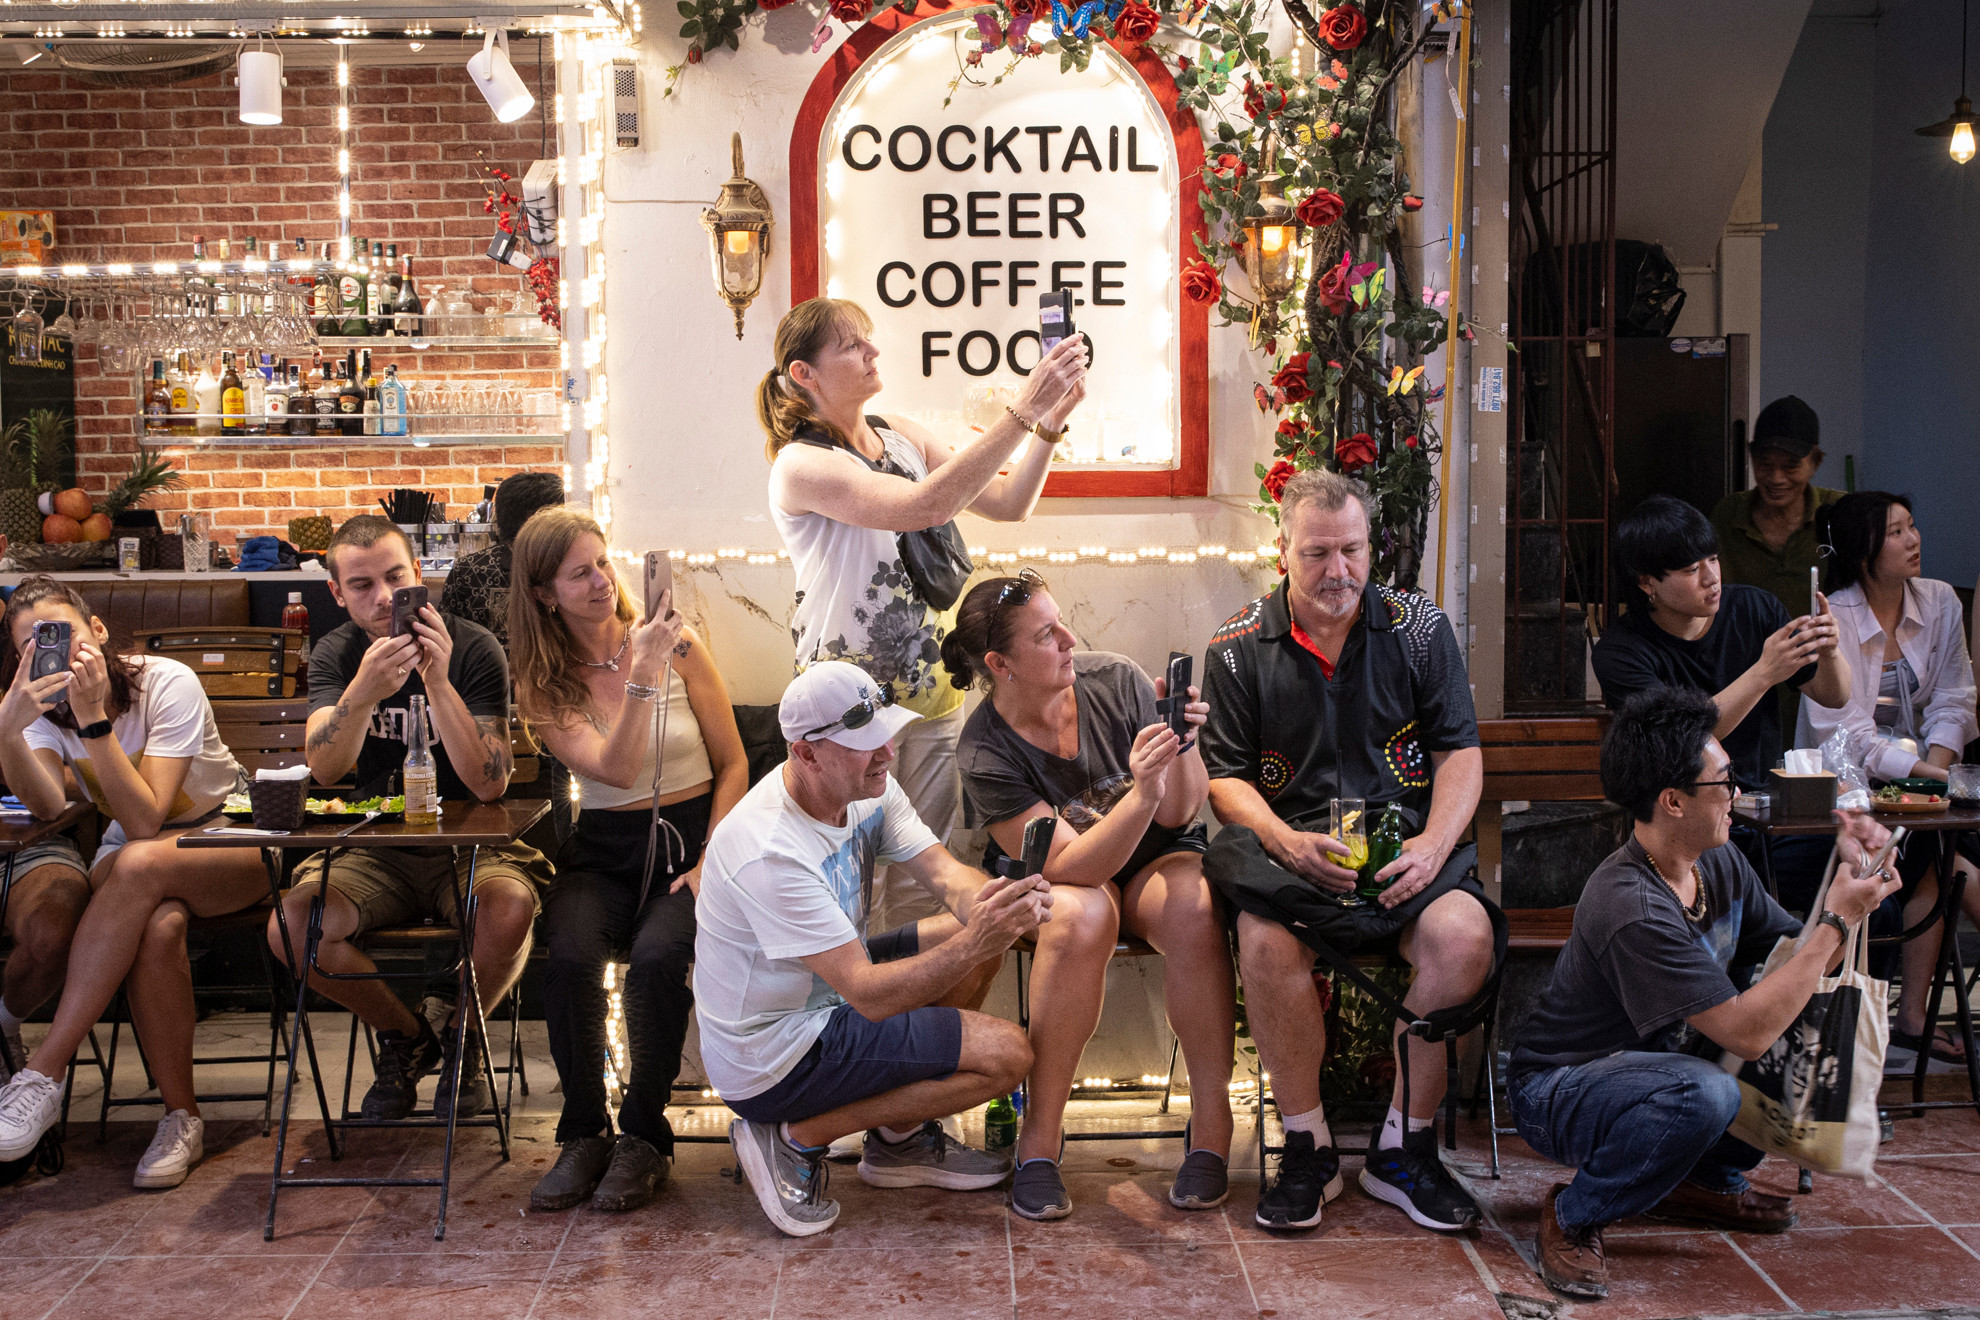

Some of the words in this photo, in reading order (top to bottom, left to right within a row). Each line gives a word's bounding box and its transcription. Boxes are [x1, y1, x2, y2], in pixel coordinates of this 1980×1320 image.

[842, 124, 1159, 174] COCKTAIL
[922, 191, 1086, 240] BEER
[876, 260, 1127, 308] COFFEE
[921, 329, 1094, 378] FOO
